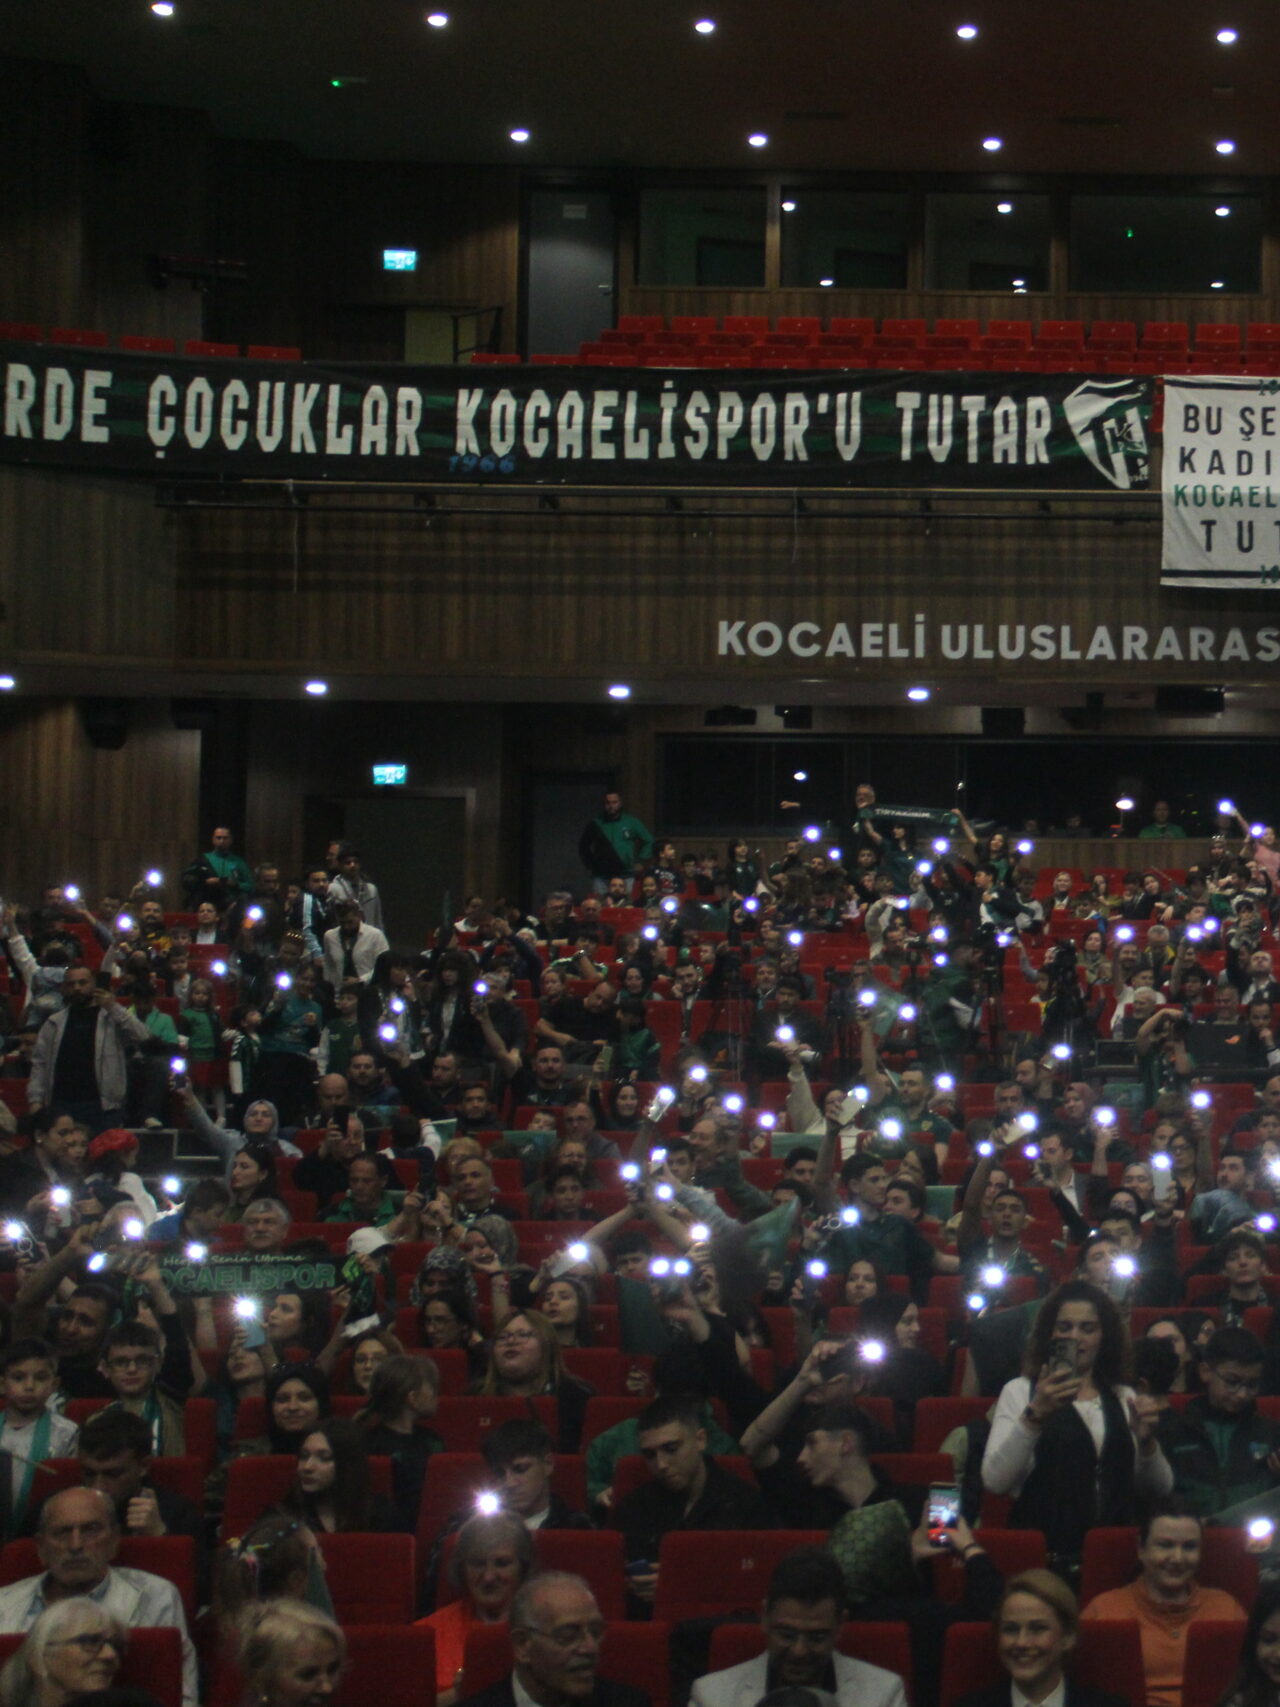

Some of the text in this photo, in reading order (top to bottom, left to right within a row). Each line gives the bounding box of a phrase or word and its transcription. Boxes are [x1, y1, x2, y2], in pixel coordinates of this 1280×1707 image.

[4, 363, 1051, 464] RDE ÇOCUKLAR KOCAELİSPOR'U TUTAR
[1183, 404, 1222, 435] BU
[718, 613, 926, 659] KOCAELİ
